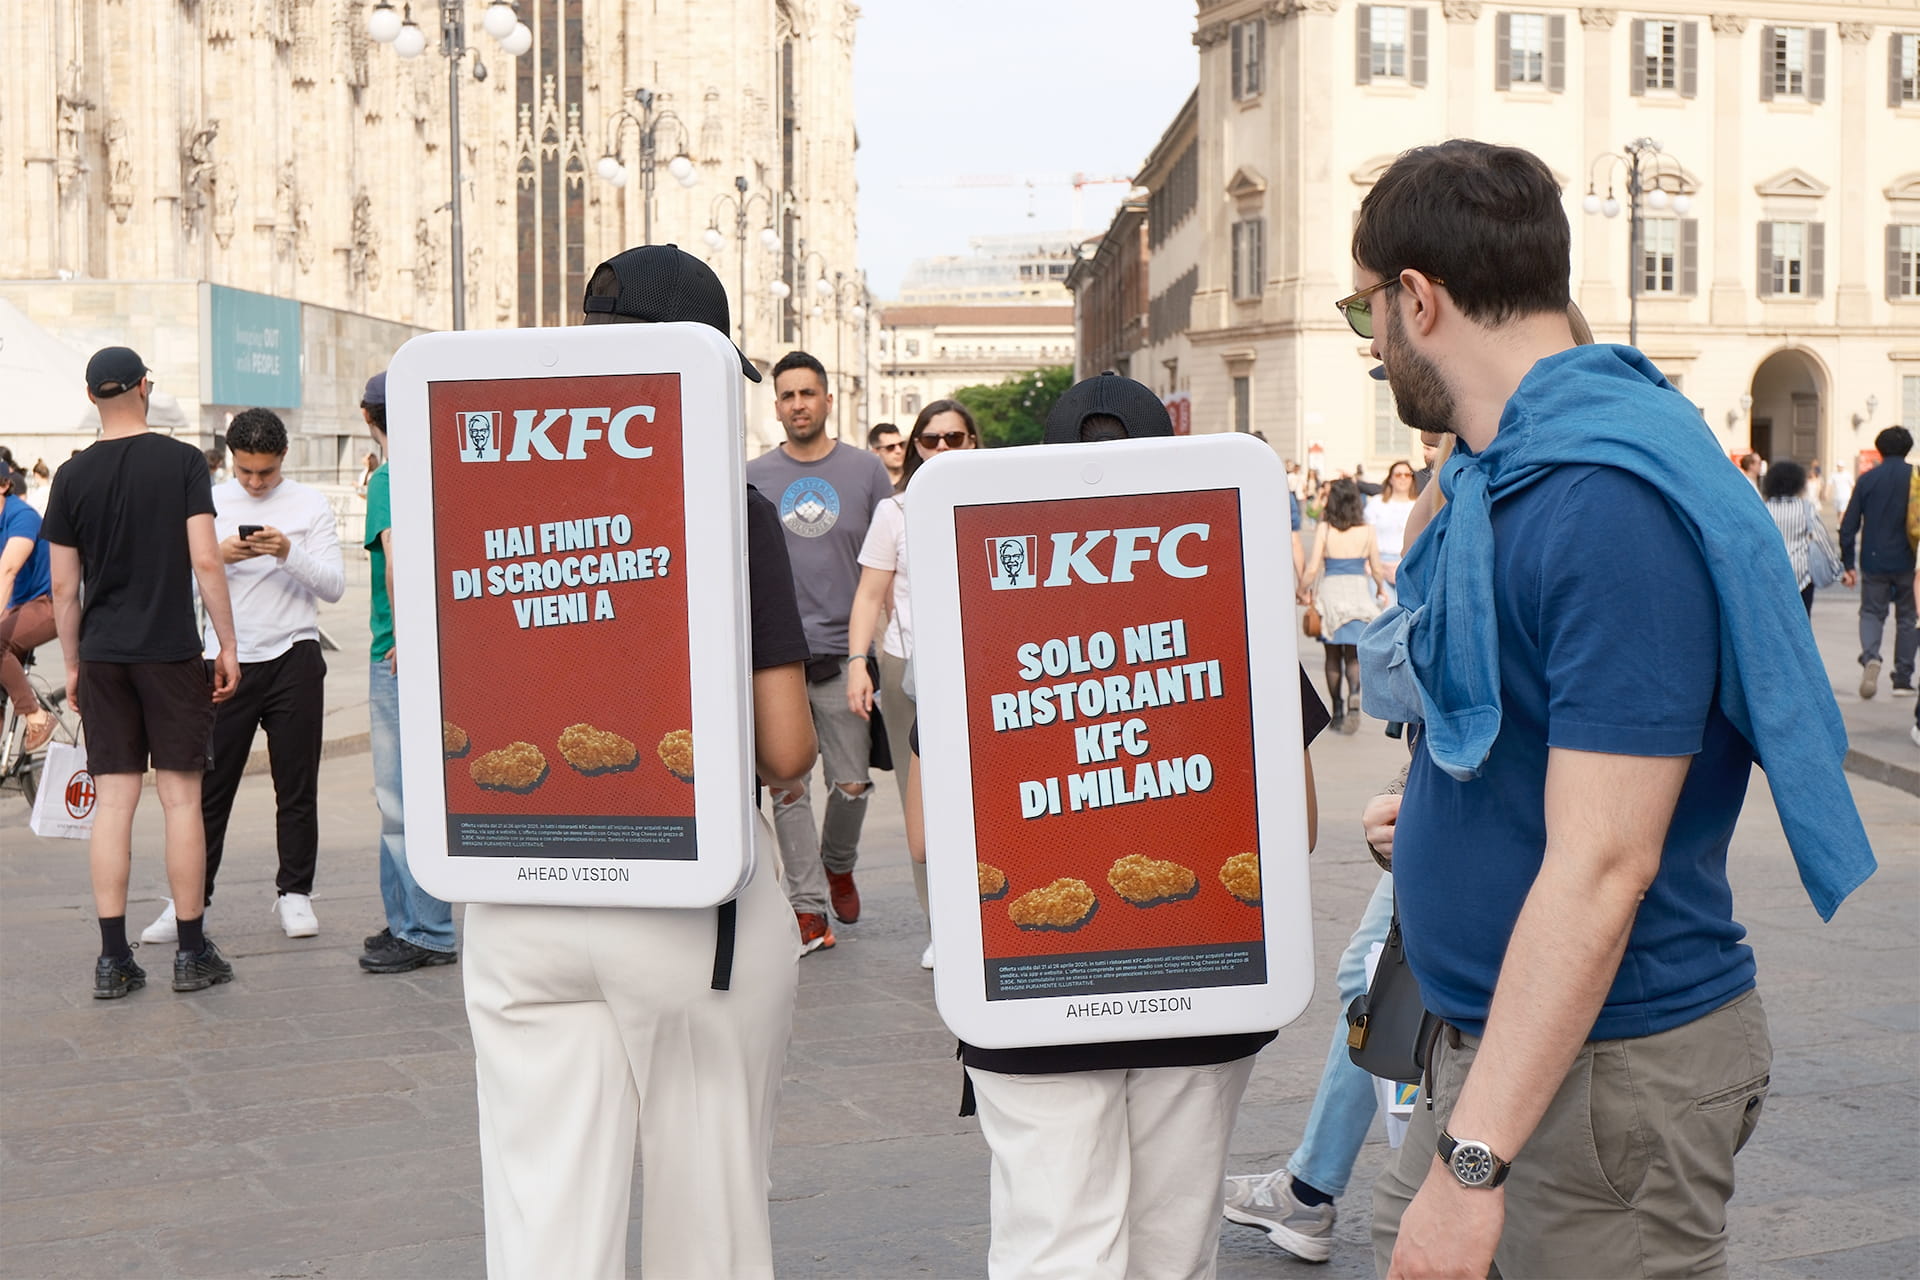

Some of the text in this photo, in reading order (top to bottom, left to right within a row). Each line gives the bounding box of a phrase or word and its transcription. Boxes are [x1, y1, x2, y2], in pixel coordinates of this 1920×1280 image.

[505, 405, 656, 462] KFC
[484, 514, 633, 560] HAI FINITO
[1043, 522, 1210, 587] KFC
[452, 546, 672, 600] DI SCROCCARE?
[512, 589, 615, 629] VIENI A
[1017, 618, 1188, 682] SOLO NEI
[991, 659, 1223, 732] RISTORANTI
[1074, 717, 1150, 765] KFC
[1018, 753, 1214, 820] DI MILANO
[517, 867, 629, 881] AHEAD VISION
[1066, 996, 1192, 1018] AHEAD VISION
